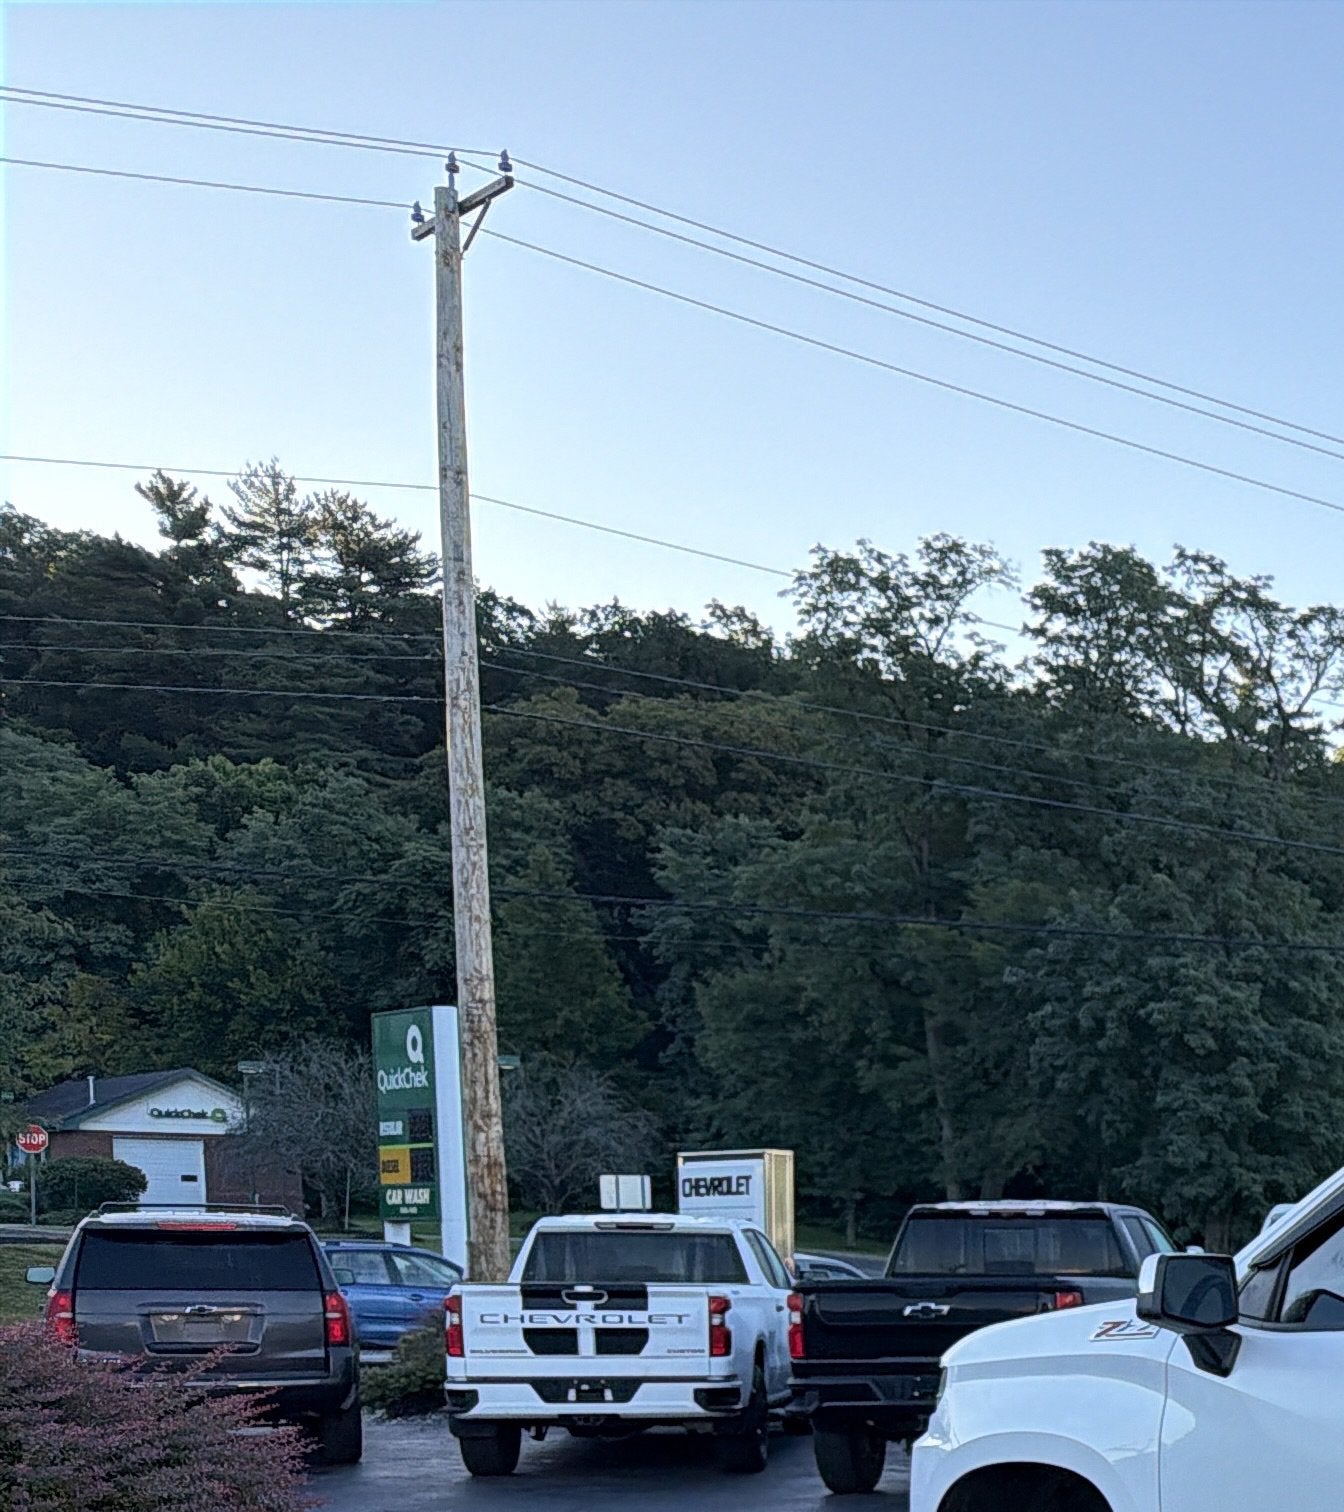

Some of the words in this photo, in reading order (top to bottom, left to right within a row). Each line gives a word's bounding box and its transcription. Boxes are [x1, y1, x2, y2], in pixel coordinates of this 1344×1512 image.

[377, 1066, 429, 1094] QuickChek
[18, 1132, 46, 1146] STOP
[681, 1174, 753, 1198] CHEVROLET
[385, 1188, 403, 1206] CAR
[404, 1187, 431, 1205] WASH
[479, 1313, 691, 1325] CHEVROLET
